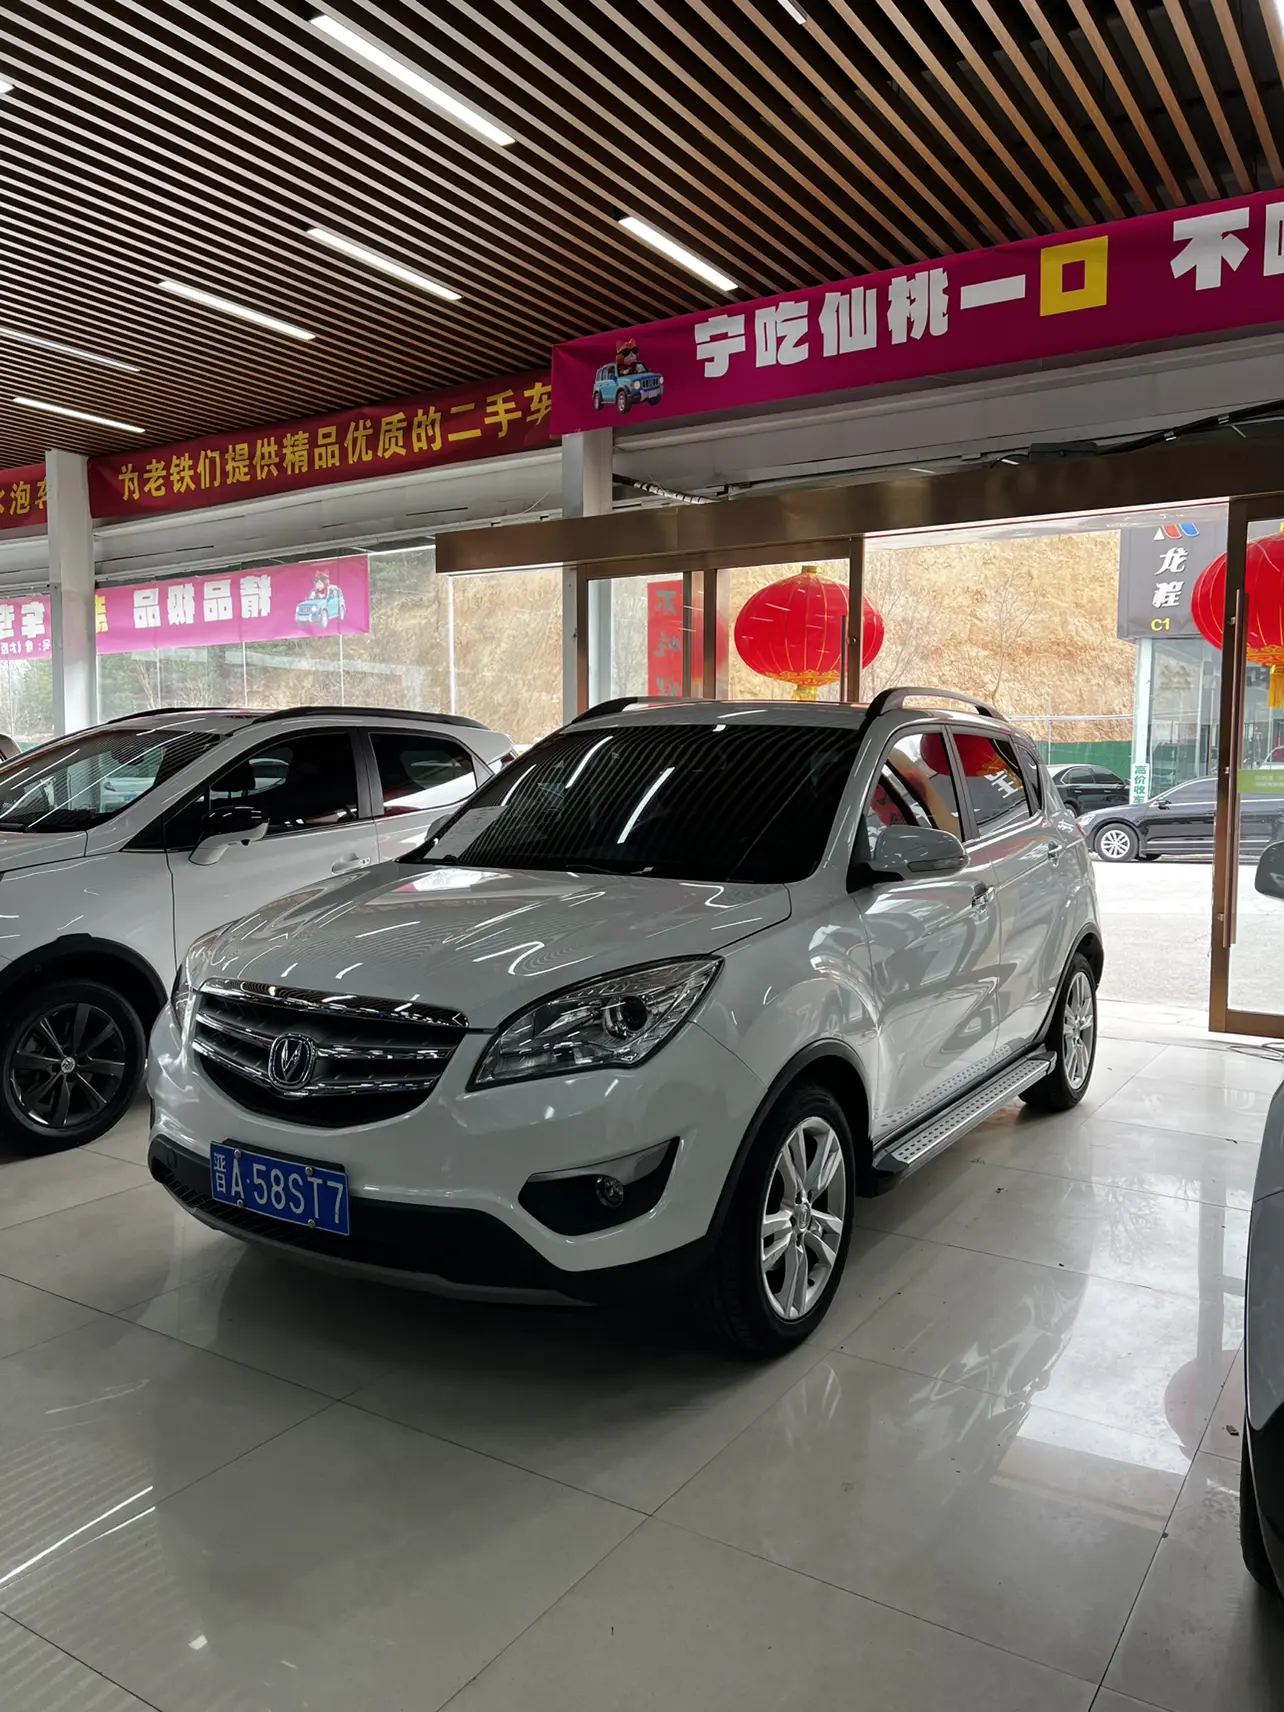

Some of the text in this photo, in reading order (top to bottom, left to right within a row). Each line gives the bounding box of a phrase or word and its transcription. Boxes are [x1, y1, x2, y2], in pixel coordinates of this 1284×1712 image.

[694, 201, 1284, 378] 宁吃仙桃一口 不
[119, 382, 551, 500] 为老铁们提供精品优质的二手车
[1152, 547, 1188, 608] 龙程
[1150, 618, 1170, 631] C1
